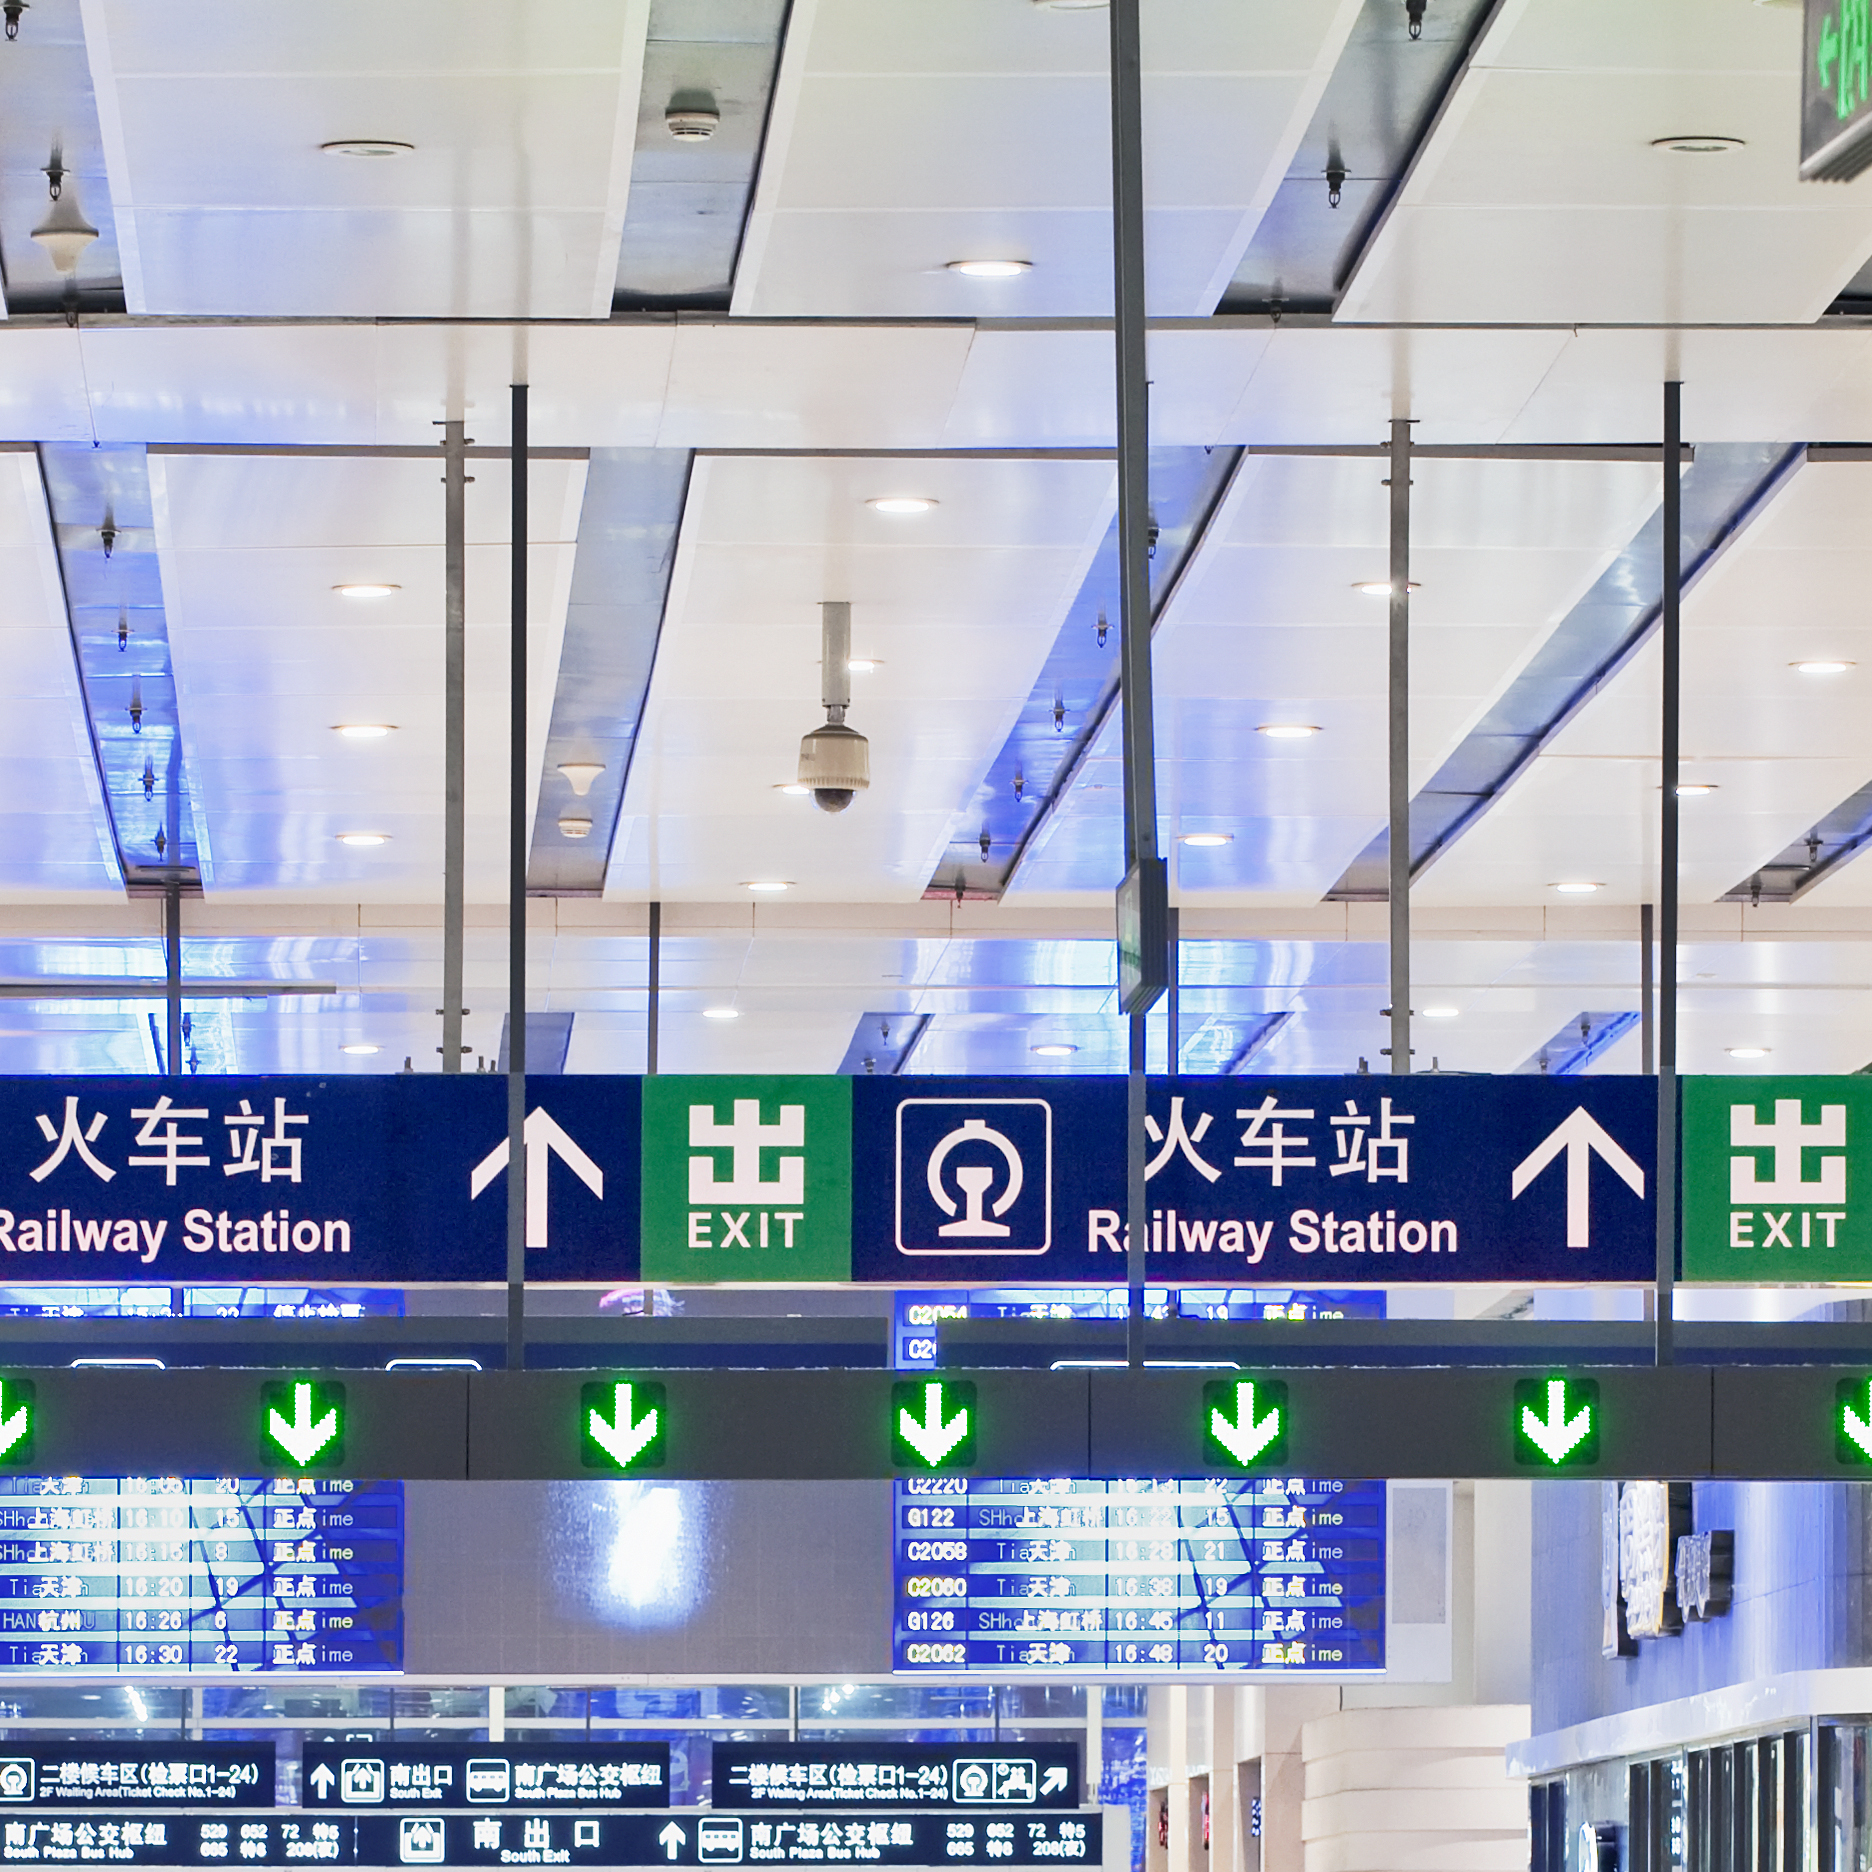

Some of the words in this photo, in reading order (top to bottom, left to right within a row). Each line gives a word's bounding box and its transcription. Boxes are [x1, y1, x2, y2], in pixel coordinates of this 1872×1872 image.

[29, 1094, 309, 1186] 火车站
[1145, 1096, 1415, 1186] 火车站
[183, 1209, 350, 1252] Station
[688, 1212, 804, 1248] EXIT
[1286, 1208, 1458, 1253] Station
[1730, 1212, 1846, 1247] EXIT
[216, 1509, 239, 1527] 15
[273, 1507, 316, 1529] 正点
[907, 1508, 955, 1527] G122
[1205, 1508, 1229, 1526] 15
[1262, 1505, 1306, 1528] 正点
[273, 1540, 316, 1563] 正点
[907, 1542, 968, 1561] C2058
[1204, 1542, 1225, 1561] 21
[1262, 1539, 1306, 1562] 正点
[126, 1577, 184, 1596] 16:20
[216, 1577, 239, 1596] 19
[273, 1575, 316, 1597] 正点
[1116, 1577, 1174, 1596] 16:38
[1206, 1577, 1228, 1595] 19
[1262, 1576, 1306, 1597] 正点
[126, 1611, 182, 1630] 16:26
[214, 1611, 227, 1630] 6
[273, 1610, 316, 1631] 正点
[907, 1611, 954, 1631] G126
[1116, 1611, 1173, 1630] 16:45
[1205, 1611, 1225, 1629] 11
[1262, 1610, 1306, 1631] 正点
[125, 1645, 183, 1664] 16:30
[214, 1645, 238, 1664] 22
[273, 1643, 316, 1665] 正点
[907, 1644, 966, 1664] C2062
[1116, 1644, 1174, 1662] 16:48
[1204, 1644, 1228, 1662] 20
[1262, 1641, 1306, 1664] 正点
[390, 1763, 452, 1788] 南出口
[39, 1787, 54, 1798] 2F
[751, 1788, 765, 1800] 2F
[281, 1824, 299, 1839] 72
[1027, 1824, 1046, 1838] 72
[500, 1850, 541, 1863] South
[543, 1850, 571, 1863] Exit
